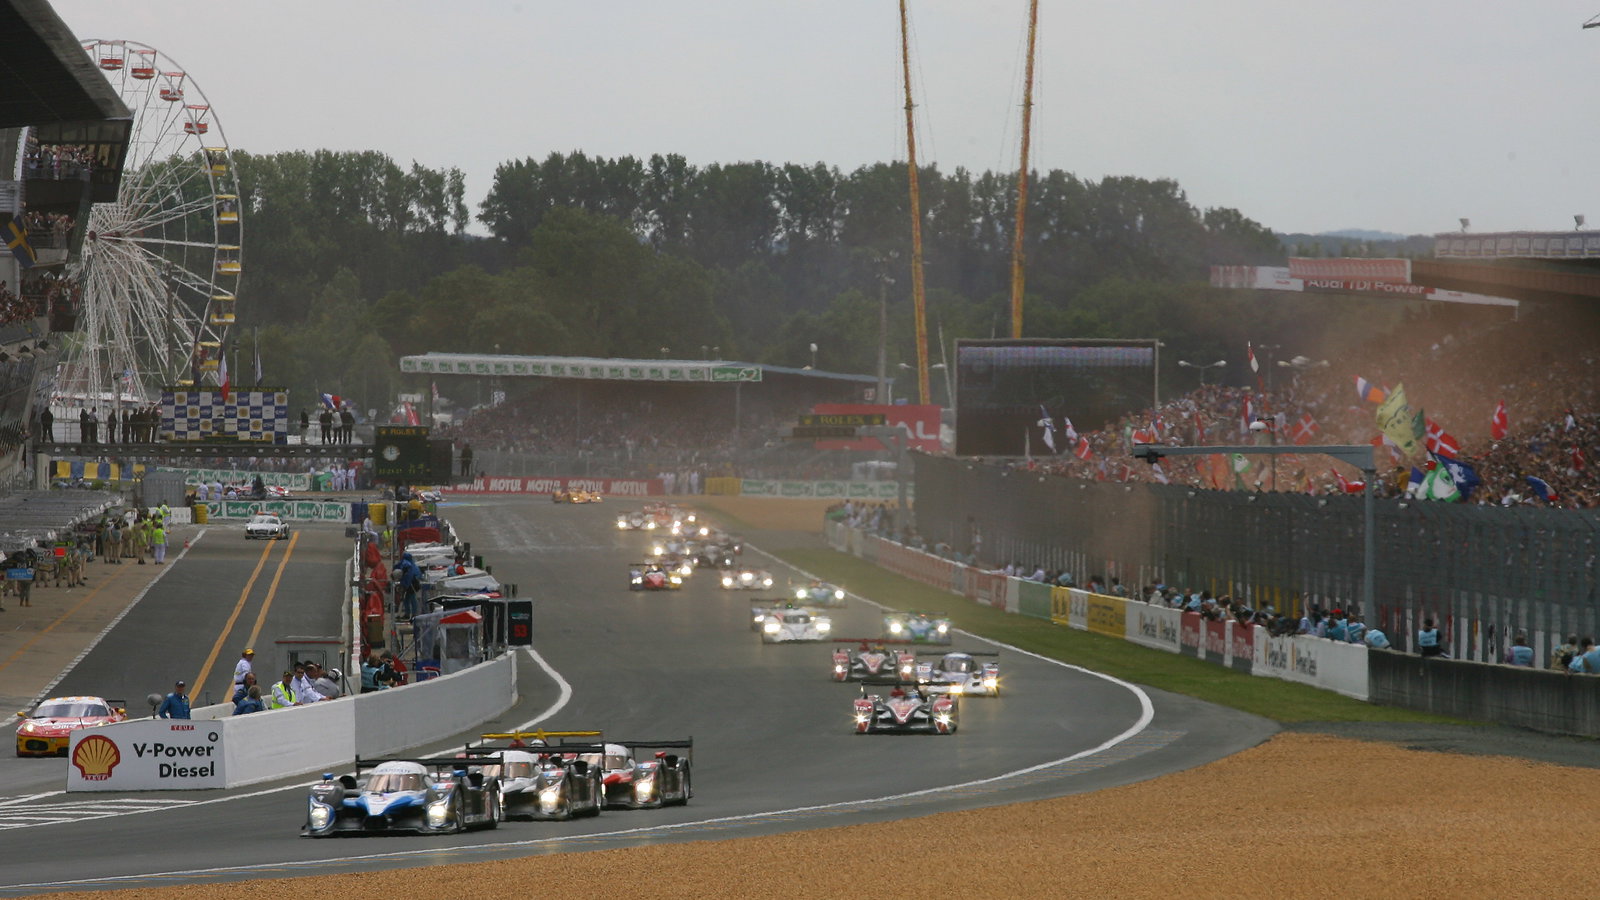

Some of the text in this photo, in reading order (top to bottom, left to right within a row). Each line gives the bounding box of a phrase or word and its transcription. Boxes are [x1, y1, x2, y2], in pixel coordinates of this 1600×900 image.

[1374, 282, 1424, 294] Power
[820, 415, 865, 425] ROLEX
[490, 478, 521, 491] MOTUL
[610, 481, 648, 495] MOTUL
[133, 743, 214, 758] V-Power
[159, 761, 215, 778] Diesel
